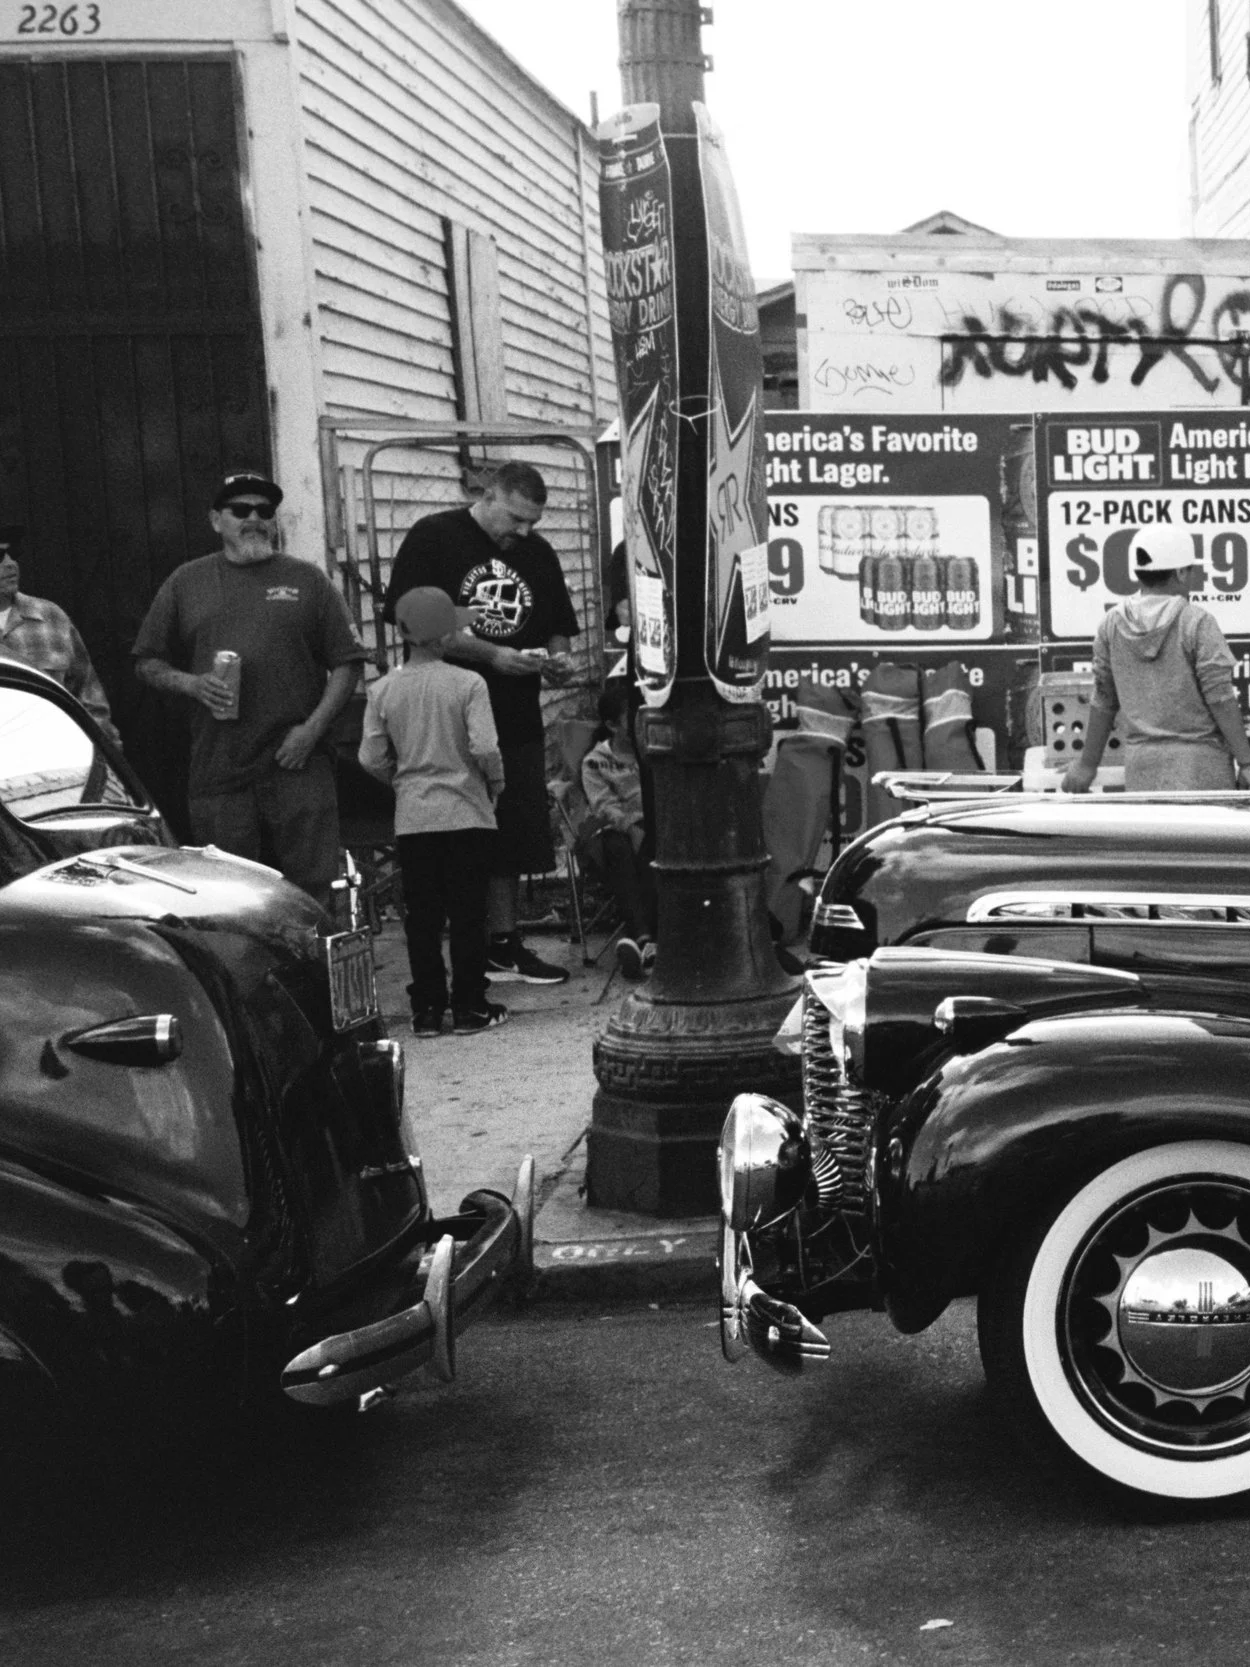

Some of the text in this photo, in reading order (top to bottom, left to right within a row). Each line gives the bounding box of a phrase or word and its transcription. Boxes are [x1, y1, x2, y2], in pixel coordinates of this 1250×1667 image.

[17, 3, 101, 36] 2263
[871, 424, 979, 452] Favorite
[1066, 428, 1141, 454] BUD
[808, 456, 891, 488] Lager.
[1053, 453, 1157, 481] LIGHT
[1171, 453, 1238, 486] Light
[1060, 499, 1174, 526] 12-PACK
